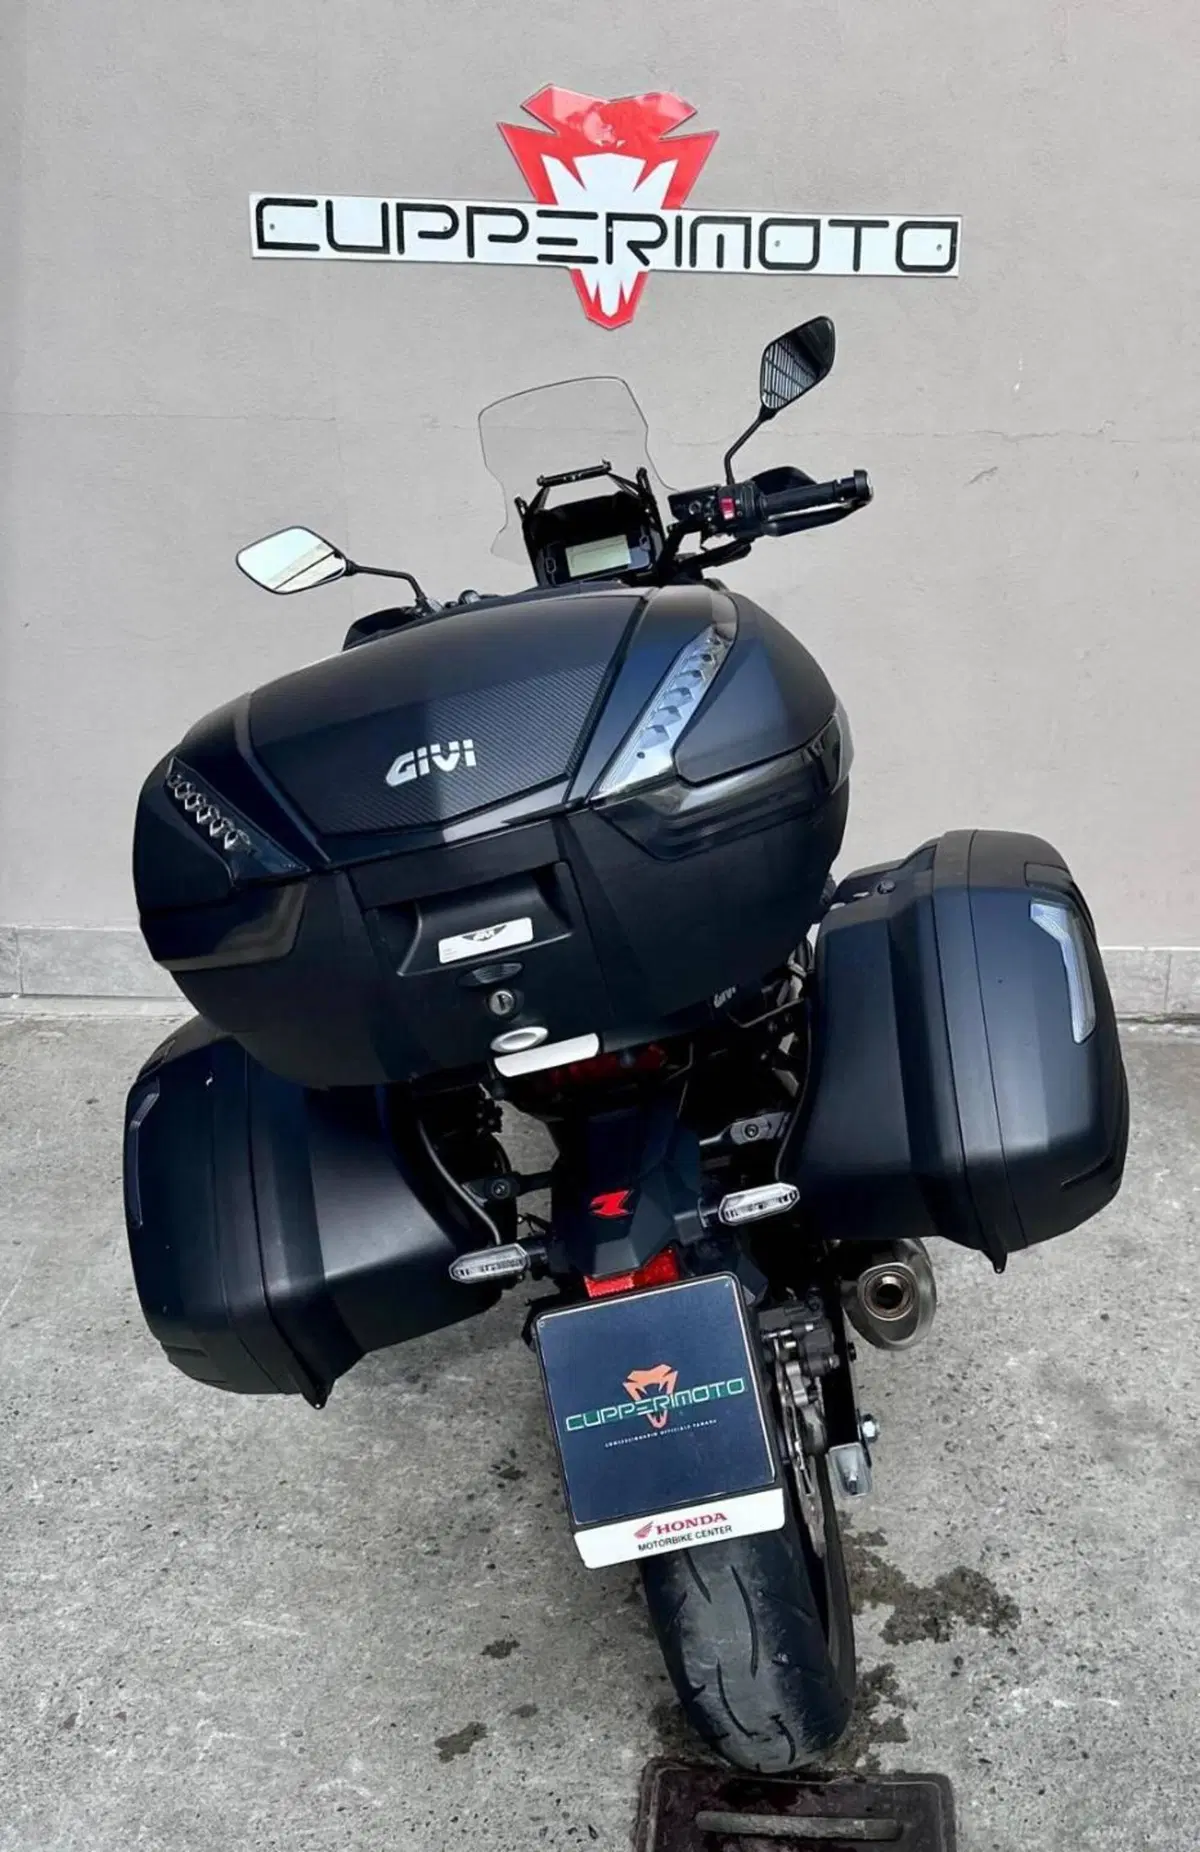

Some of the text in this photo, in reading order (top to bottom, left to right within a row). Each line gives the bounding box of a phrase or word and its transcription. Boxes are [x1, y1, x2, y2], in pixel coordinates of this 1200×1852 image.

[255, 197, 959, 274] CUPPERIMOTO
[385, 738, 477, 788] GIVI
[565, 1377, 746, 1432] CUPPERIMOTO
[638, 1524, 733, 1552] MOTORBIKE CENTER
[656, 1512, 728, 1535] HONDA
